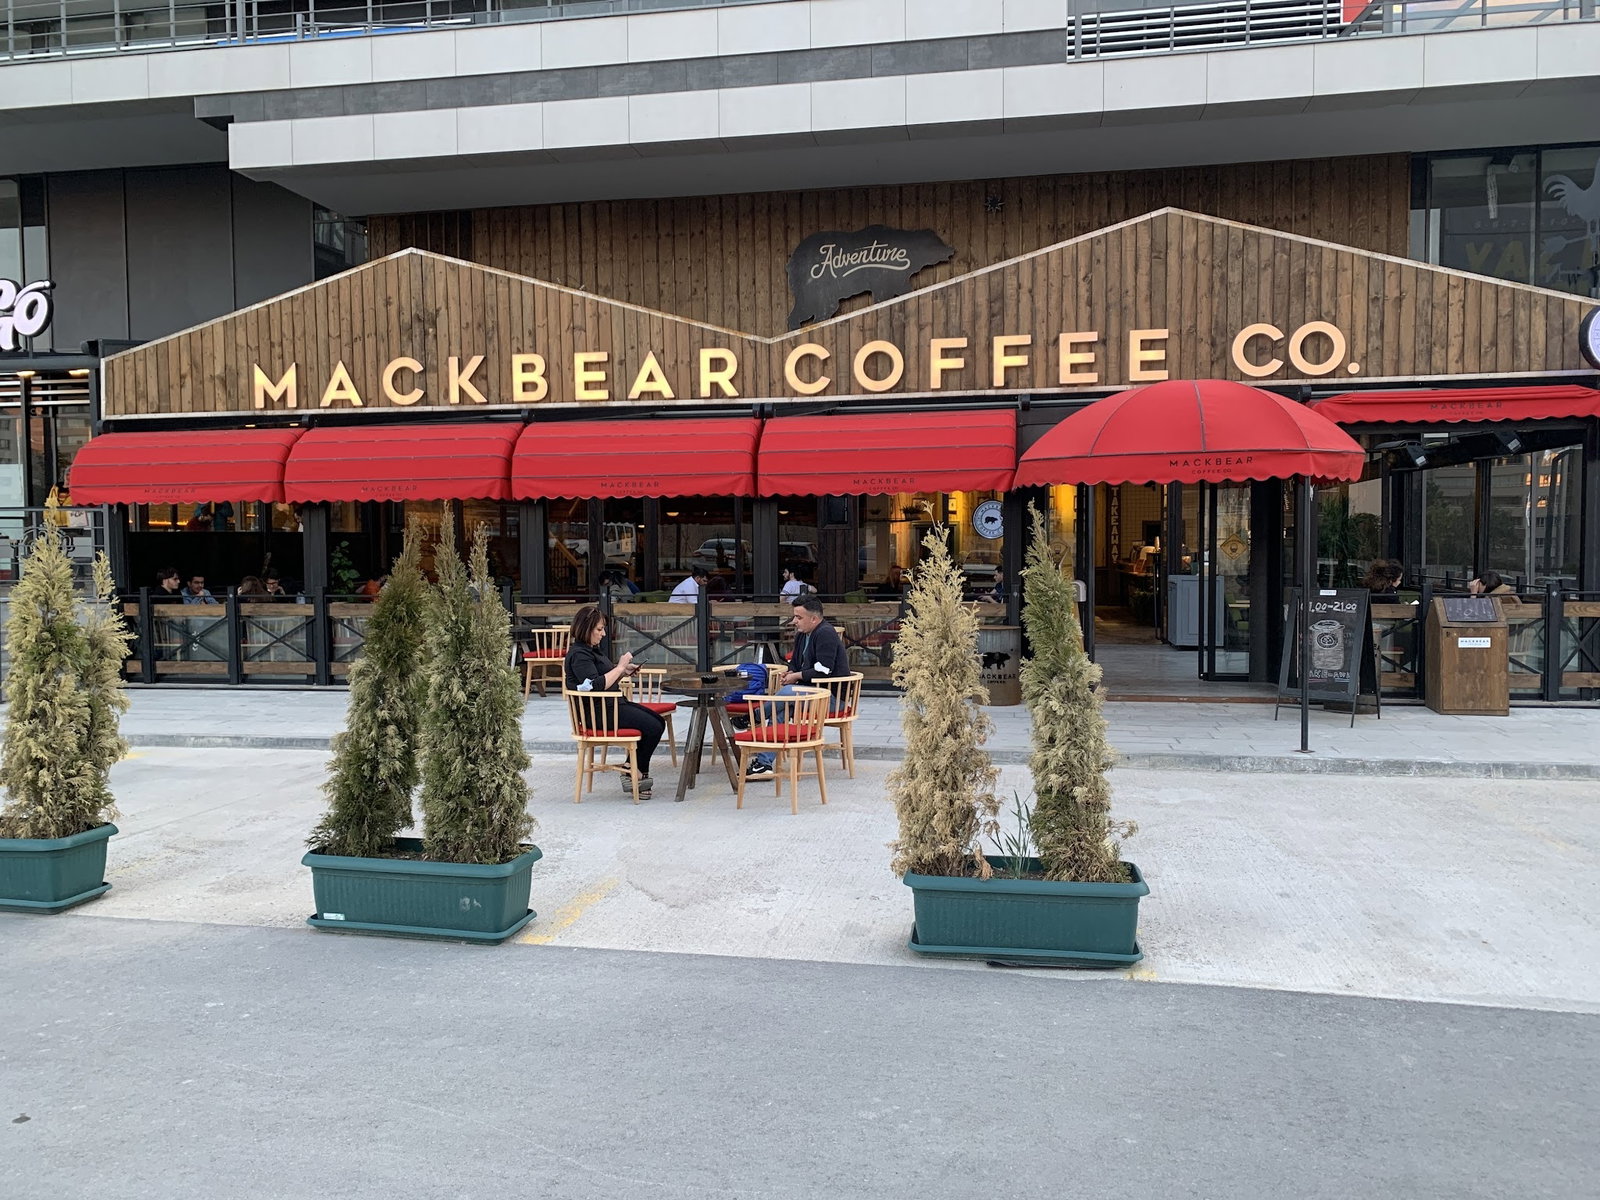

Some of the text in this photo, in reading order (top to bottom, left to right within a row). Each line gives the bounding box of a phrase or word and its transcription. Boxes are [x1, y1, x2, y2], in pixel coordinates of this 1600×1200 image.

[810, 239, 911, 279] Adventure
[253, 320, 1361, 409] MACKBEAR COFFEE CO.
[1169, 456, 1254, 468] MACKBEAR
[600, 481, 660, 489] MACKBEAR
[853, 477, 915, 485] MACKBEAR
[1110, 487, 1119, 564] TAKEAWAY
